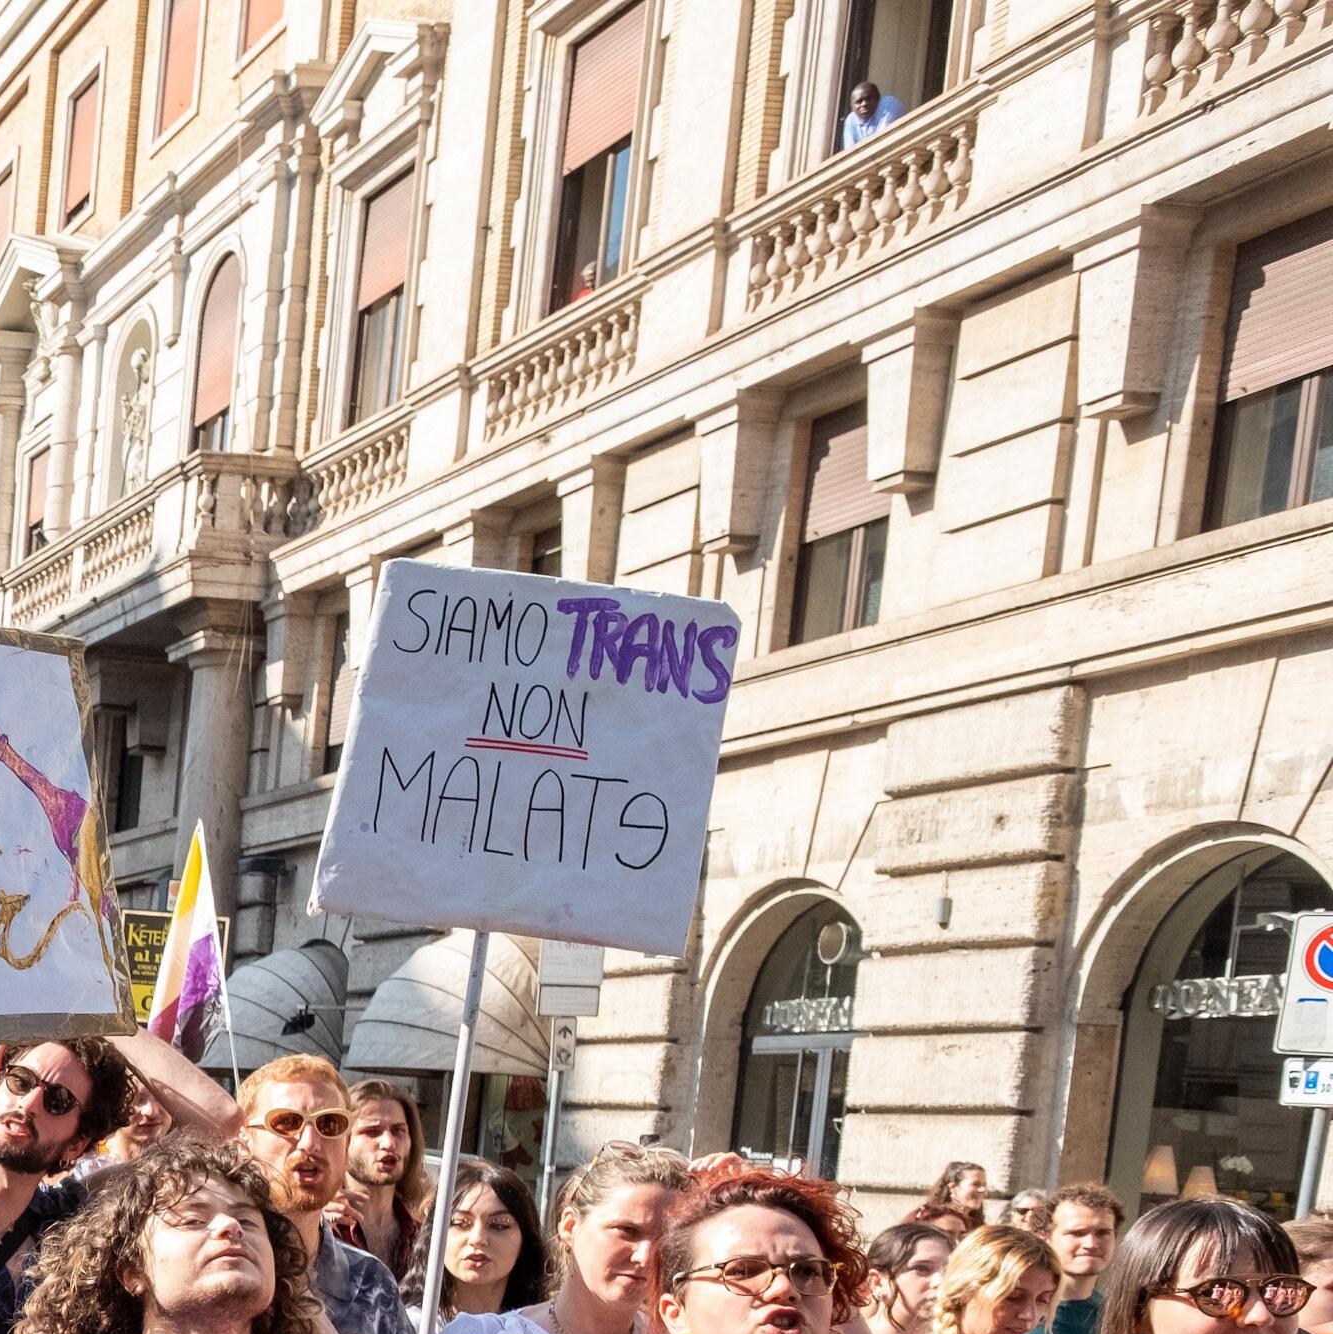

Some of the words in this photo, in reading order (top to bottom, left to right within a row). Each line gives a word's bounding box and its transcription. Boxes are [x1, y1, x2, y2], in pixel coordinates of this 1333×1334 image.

[393, 590, 548, 667] SIAMO
[556, 597, 738, 704] TRANS
[482, 681, 589, 748] NON
